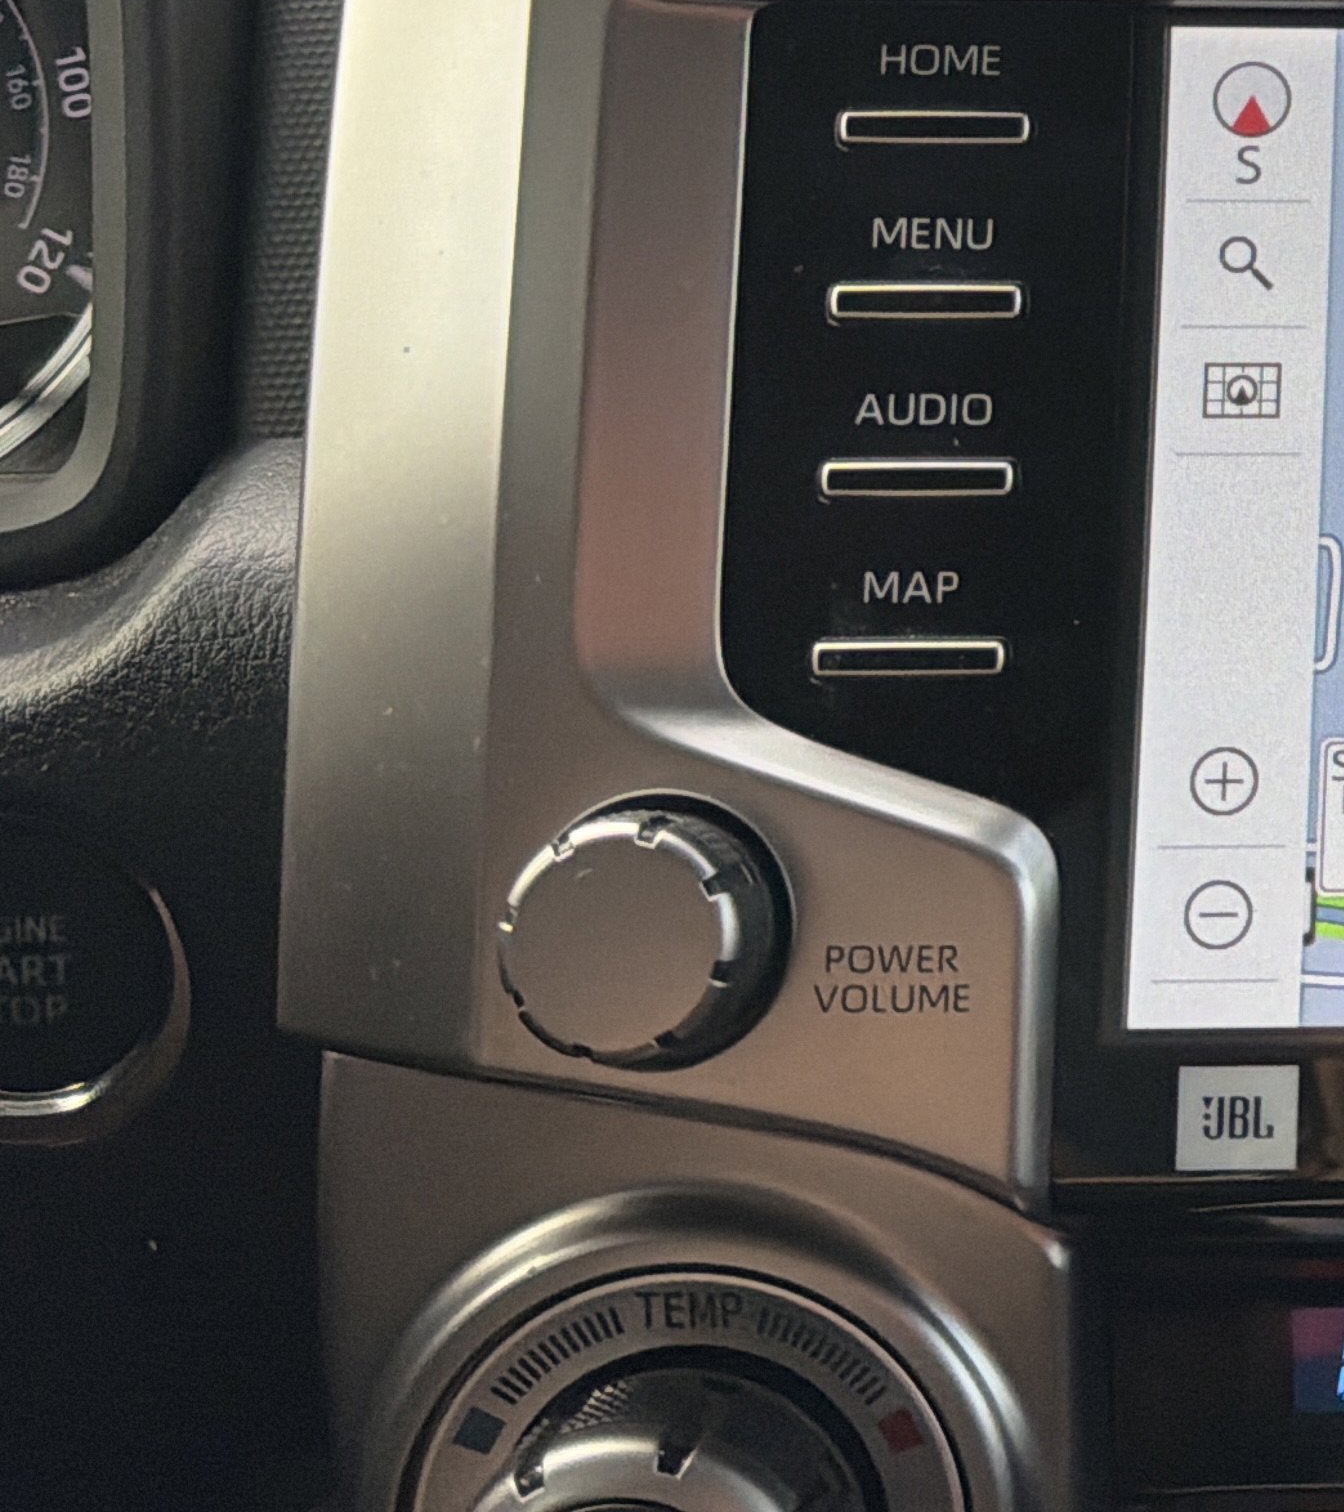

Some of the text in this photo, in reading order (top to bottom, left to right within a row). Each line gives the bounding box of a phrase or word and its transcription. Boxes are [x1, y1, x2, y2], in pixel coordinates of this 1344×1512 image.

[880, 43, 1001, 76] HOME
[54, 46, 92, 118] 100
[4, 154, 32, 198] 180
[1236, 145, 1261, 184] S
[871, 217, 995, 250] MENU
[16, 227, 73, 294] 120
[854, 392, 994, 426] AUDIO
[862, 571, 961, 604] MAP
[825, 944, 959, 973] POWER
[814, 984, 970, 1013] VOLUME
[1202, 1095, 1275, 1140] JBL
[634, 1290, 744, 1330] TEMP
